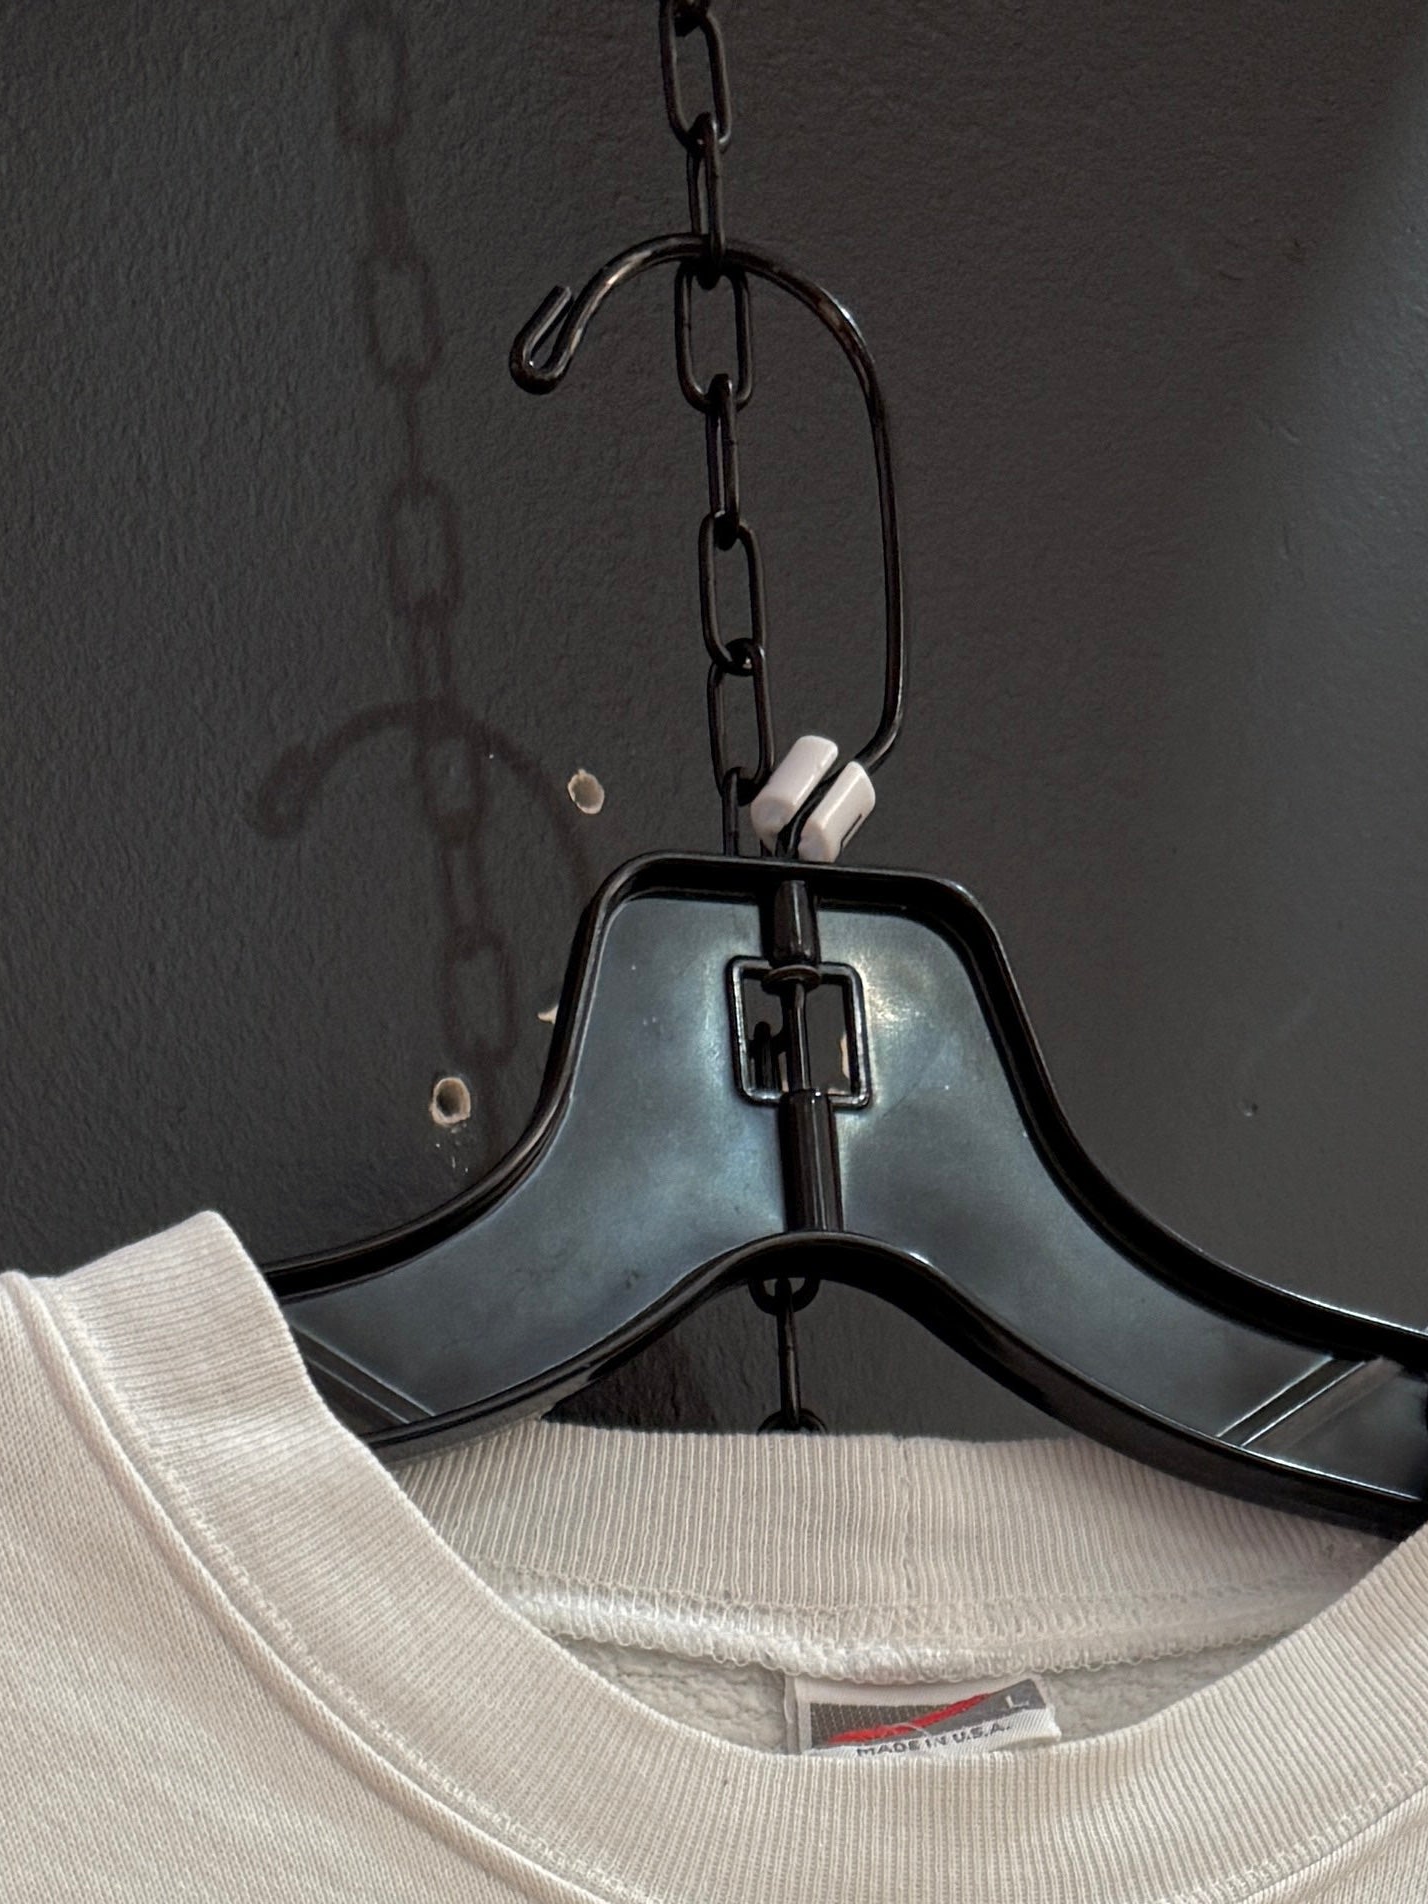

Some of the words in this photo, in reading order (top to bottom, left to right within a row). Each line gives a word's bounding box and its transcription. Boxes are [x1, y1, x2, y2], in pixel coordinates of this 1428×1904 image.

[1005, 1695, 1030, 1709] L
[856, 1739, 920, 1757] MADE
[925, 1734, 947, 1750] IN
[952, 1722, 1011, 1744] U.S.A.
